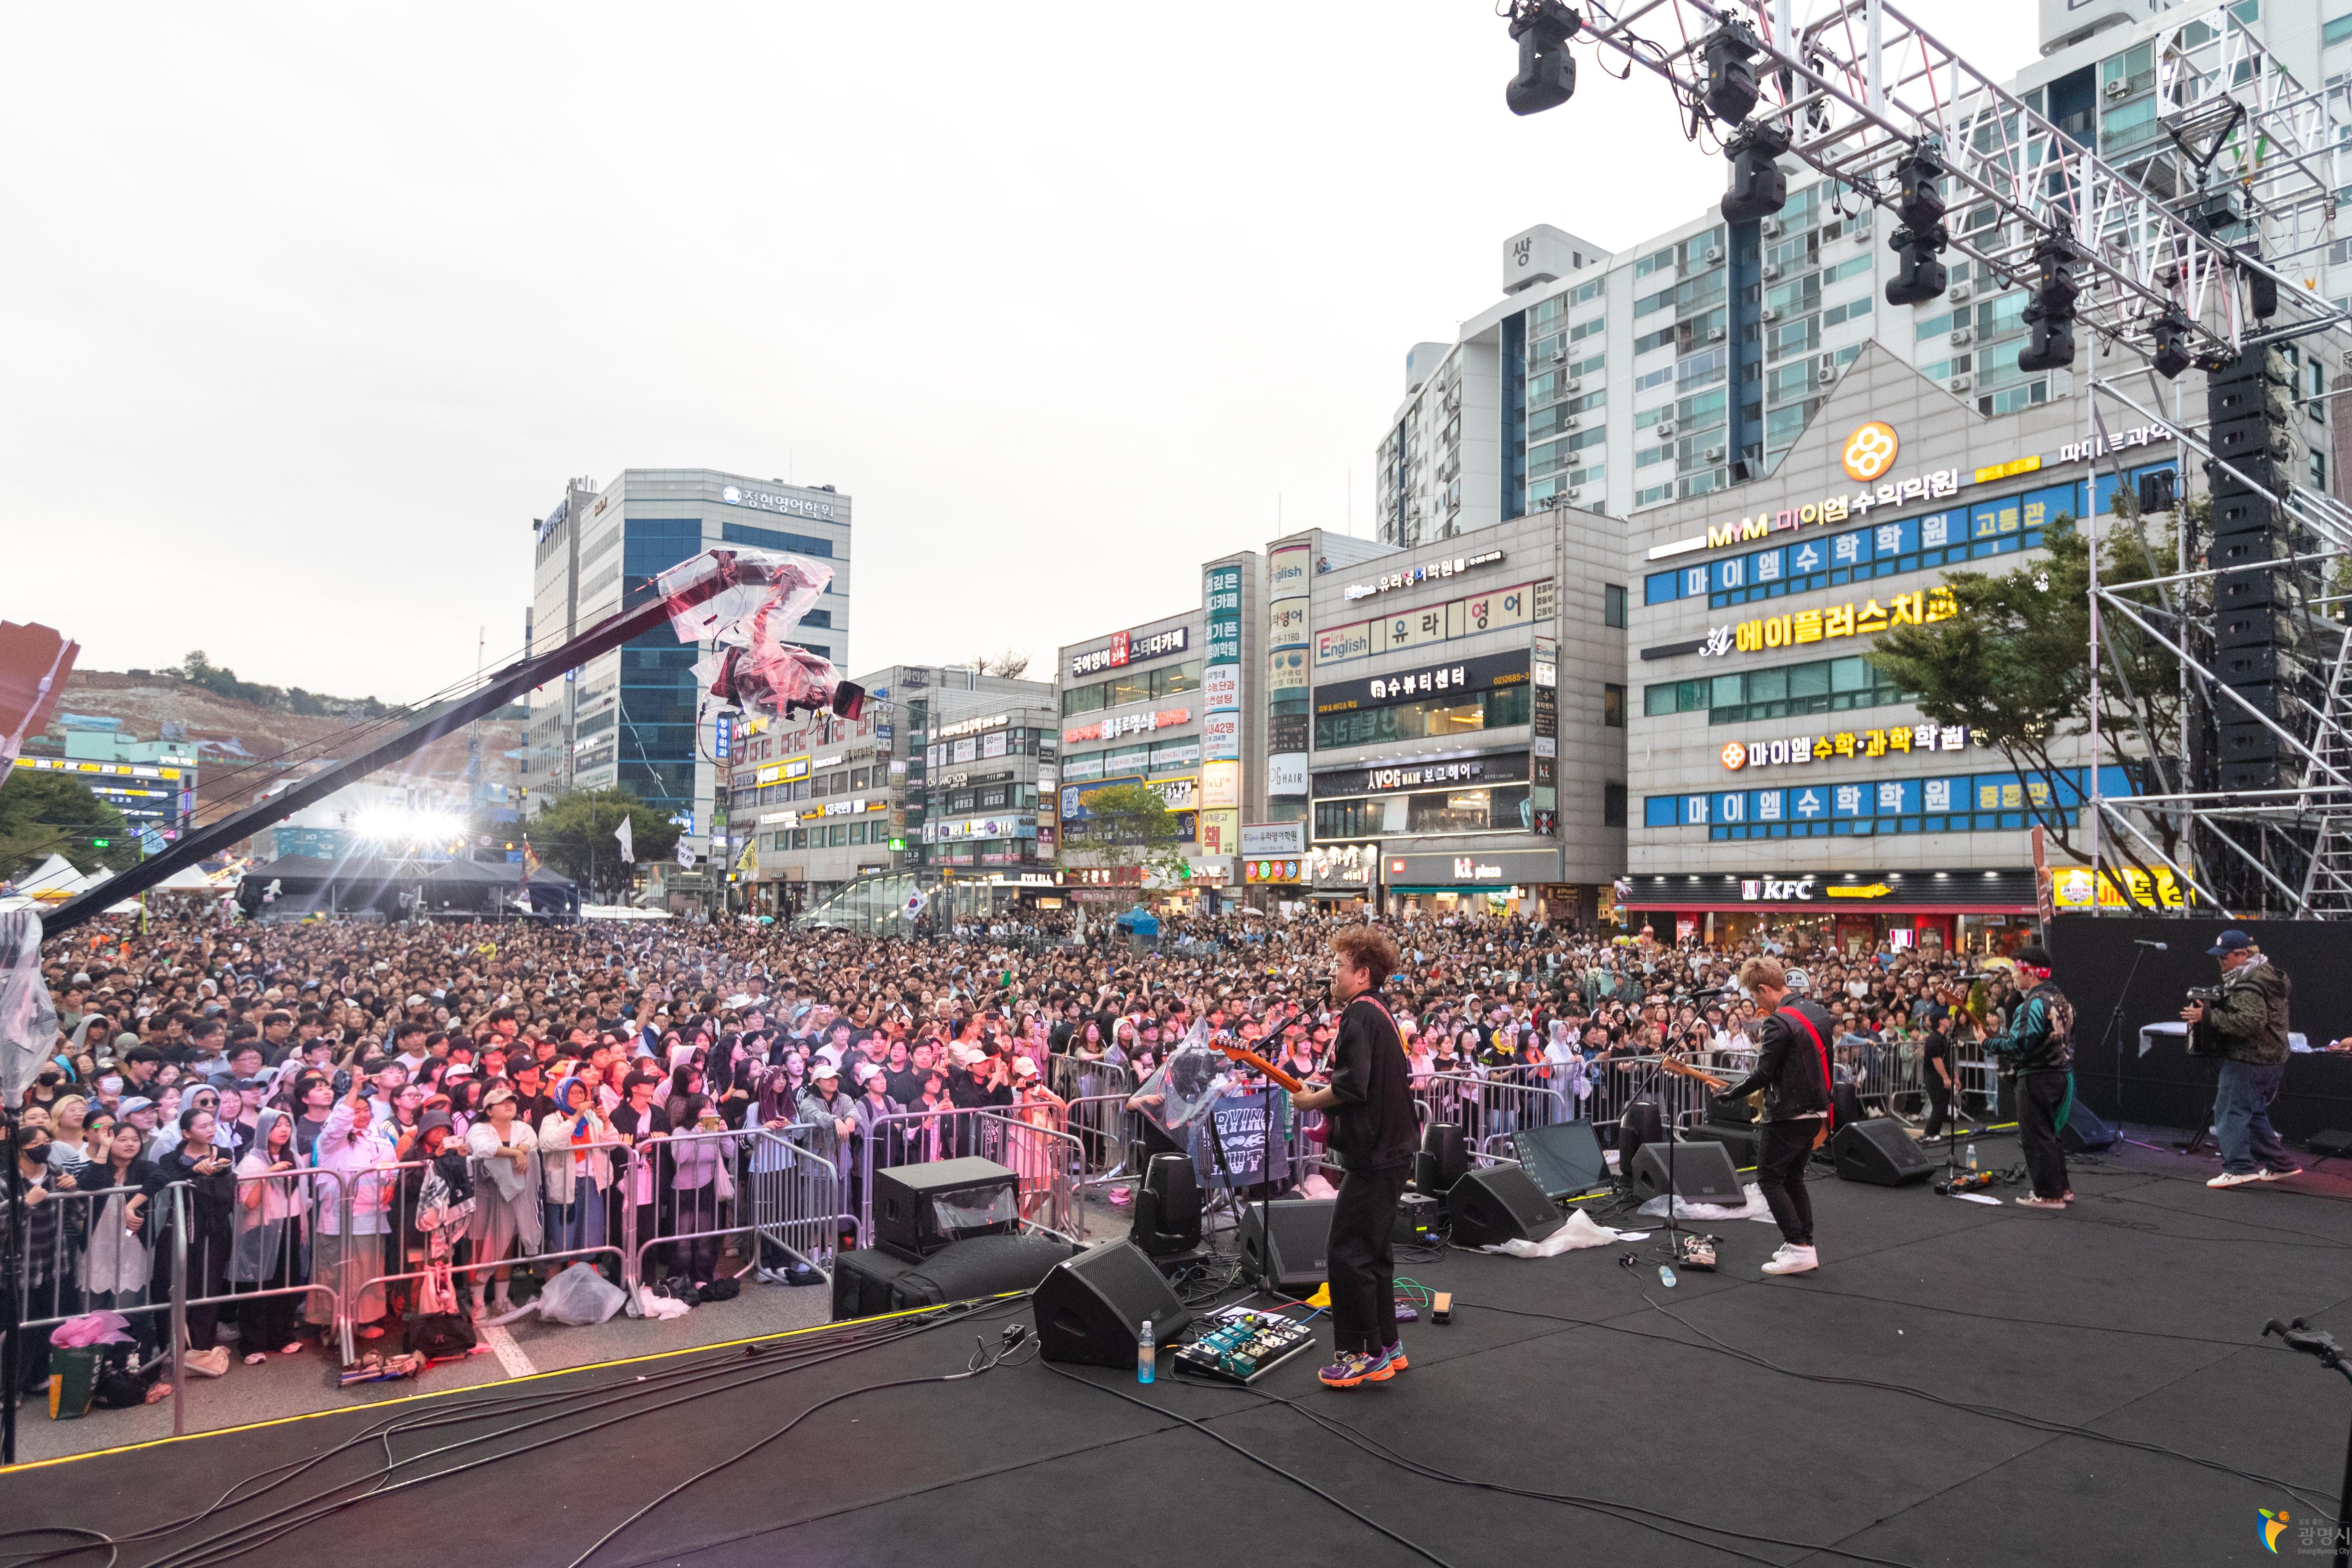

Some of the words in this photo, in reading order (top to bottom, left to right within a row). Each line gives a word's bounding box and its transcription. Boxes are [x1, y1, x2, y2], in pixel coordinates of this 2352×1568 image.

[1513, 237, 1532, 267] 쌍
[1708, 513, 1768, 548] MYM
[1776, 495, 1848, 530] 마이엠
[1853, 469, 1958, 514] 수학학원
[1688, 514, 1948, 596] 마이엠수학학원
[1976, 501, 2045, 538] 고등관
[1273, 566, 1302, 583] nglish
[1380, 559, 1453, 592] 유라영어학원
[1130, 628, 1184, 658] 스터디카페
[1320, 636, 1367, 658] English
[1073, 649, 1110, 673] 국어영어
[1388, 666, 1464, 697] 수뷰티센터
[1114, 711, 1156, 737] 종로엠스쿨
[953, 772, 968, 784] HOON
[1282, 773, 1302, 784] HAIR
[1376, 769, 1401, 789] VOG
[1402, 772, 1421, 785] HAIR
[1423, 764, 1470, 783] 보그헤어
[1539, 765, 1549, 778] kt
[954, 798, 973, 809] 성형외과
[984, 794, 1004, 806] 성형외과
[1689, 780, 1950, 823] 마이엠수학학원
[1204, 825, 1220, 854] 책
[1260, 830, 1297, 842] 유라영어학원
[1454, 857, 1473, 878] kt
[1475, 864, 1502, 880] plaza
[1762, 880, 1814, 900] KFC
